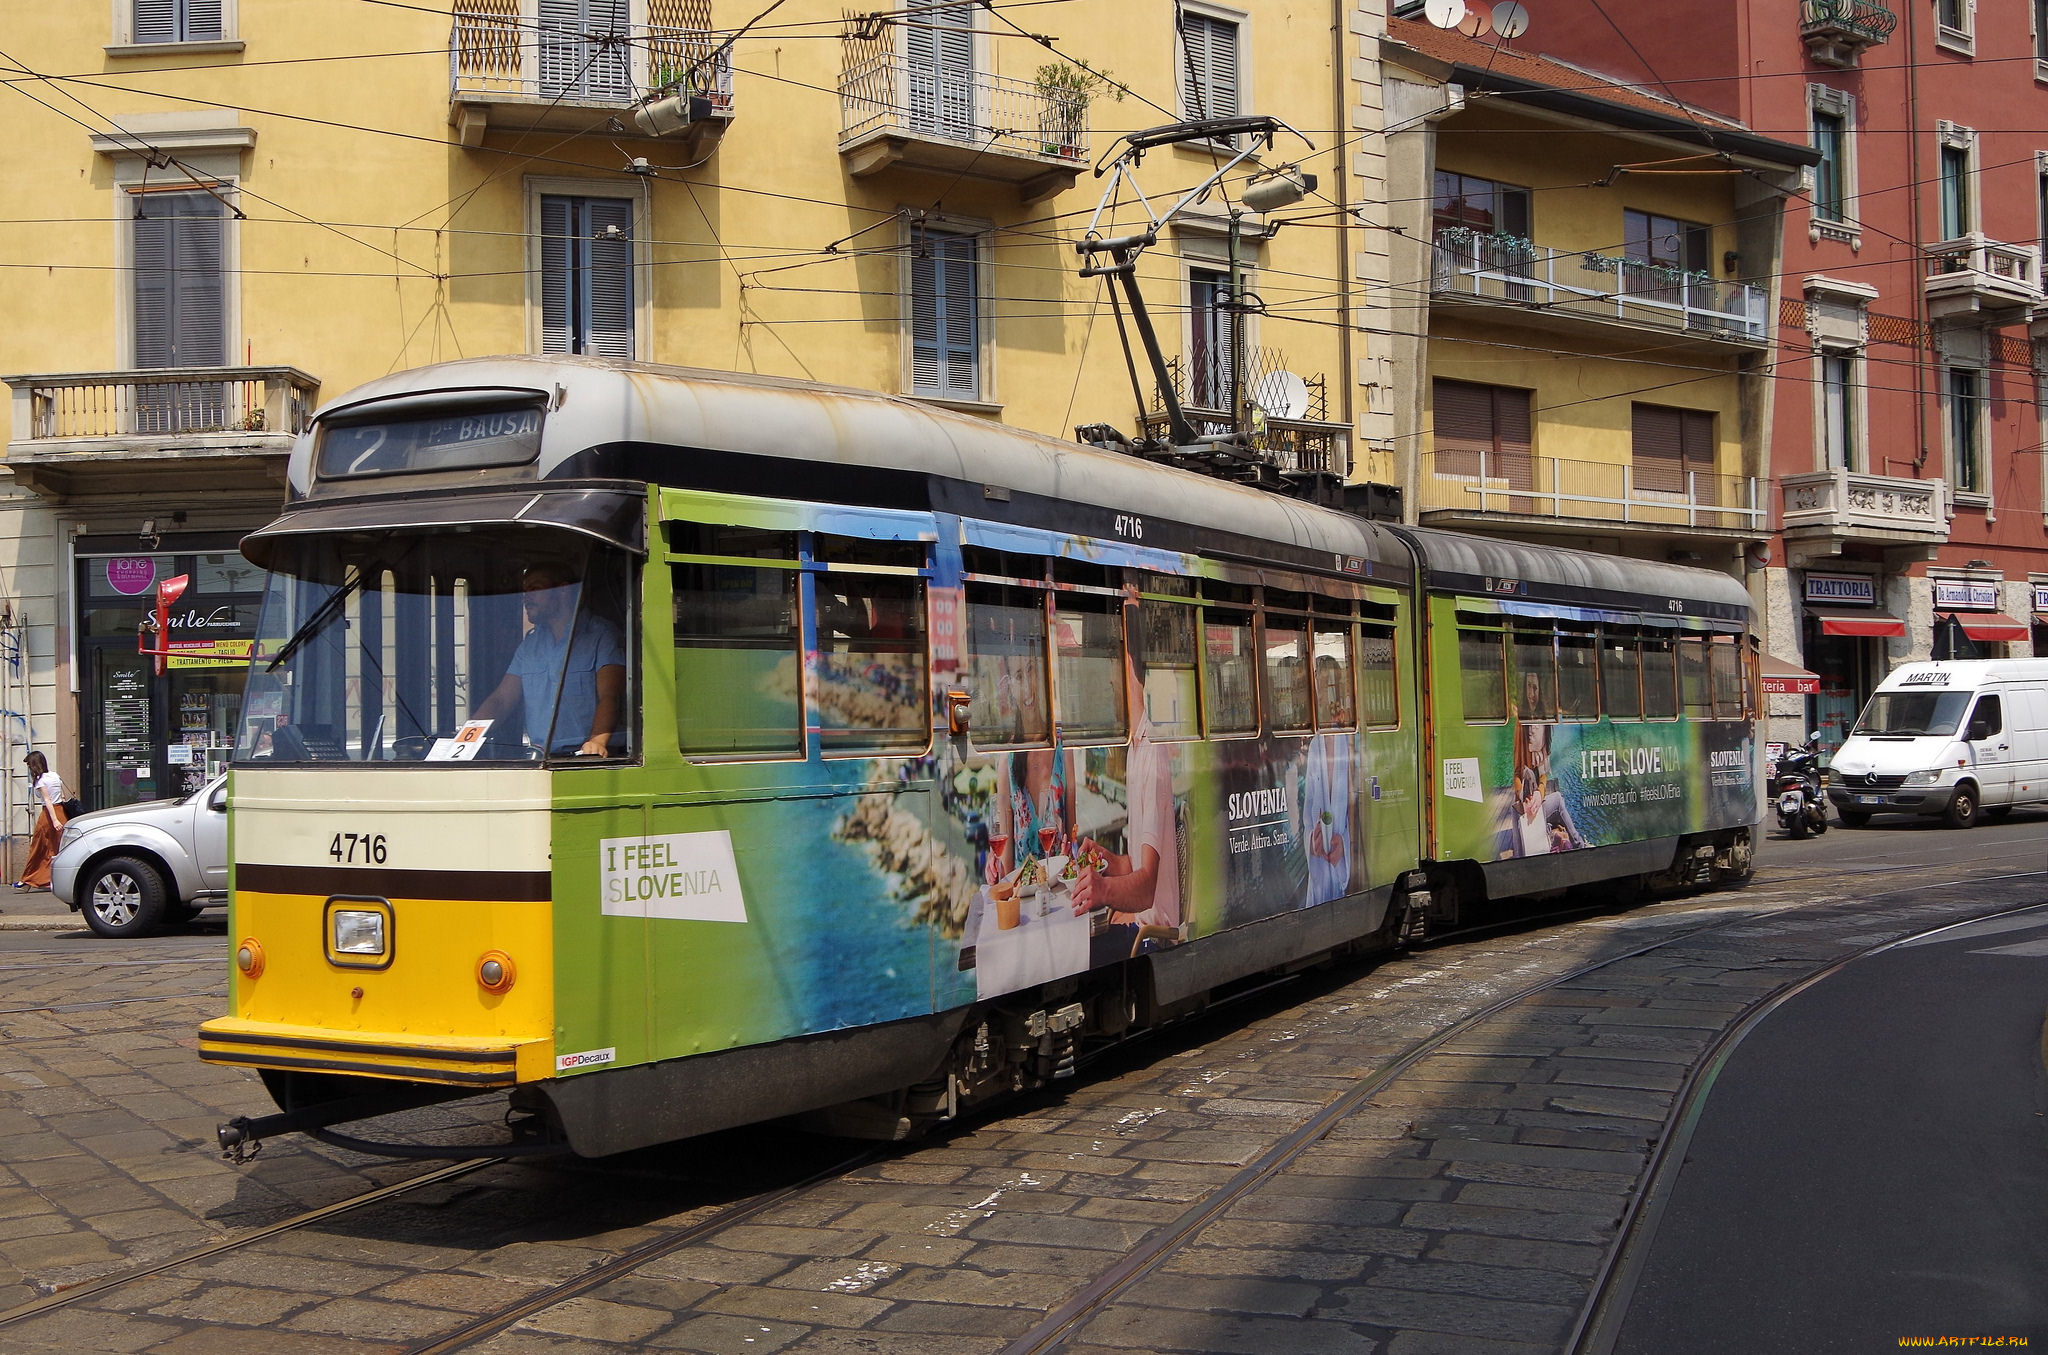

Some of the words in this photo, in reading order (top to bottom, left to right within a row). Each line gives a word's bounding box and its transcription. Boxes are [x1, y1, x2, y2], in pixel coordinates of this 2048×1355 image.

[347, 425, 387, 474] 2
[1114, 514, 1143, 540] 4716
[1808, 579, 1871, 597] TRATTORIA
[1938, 586, 1945, 601] Da
[1946, 587, 1967, 602] Armando
[1973, 588, 1993, 602] Christian
[1668, 599, 1683, 612] 4716
[1761, 680, 1785, 692] teria
[1797, 679, 1813, 692] bar
[1905, 672, 1951, 683] MARTIN
[463, 727, 477, 742] 6
[450, 744, 466, 759] 2
[1710, 750, 1745, 767] SLOVENIA
[1445, 763, 1449, 775] I
[1449, 762, 1464, 775] FEEL
[1581, 750, 1587, 779] I
[1590, 749, 1621, 778] FEEL
[1622, 746, 1681, 776] SLOVENIA
[1228, 787, 1288, 821] SLOVENIA
[1582, 787, 1637, 808] www.slovenia.info
[329, 832, 387, 864] 4716
[1229, 834, 1250, 854] Verde.
[1251, 833, 1273, 850] Attiva.
[1273, 829, 1290, 846] Sana.
[607, 846, 616, 872] I
[624, 843, 678, 871] FEEL
[608, 869, 722, 903] SLOVENIA
[561, 1053, 610, 1067] IGPDecaux
